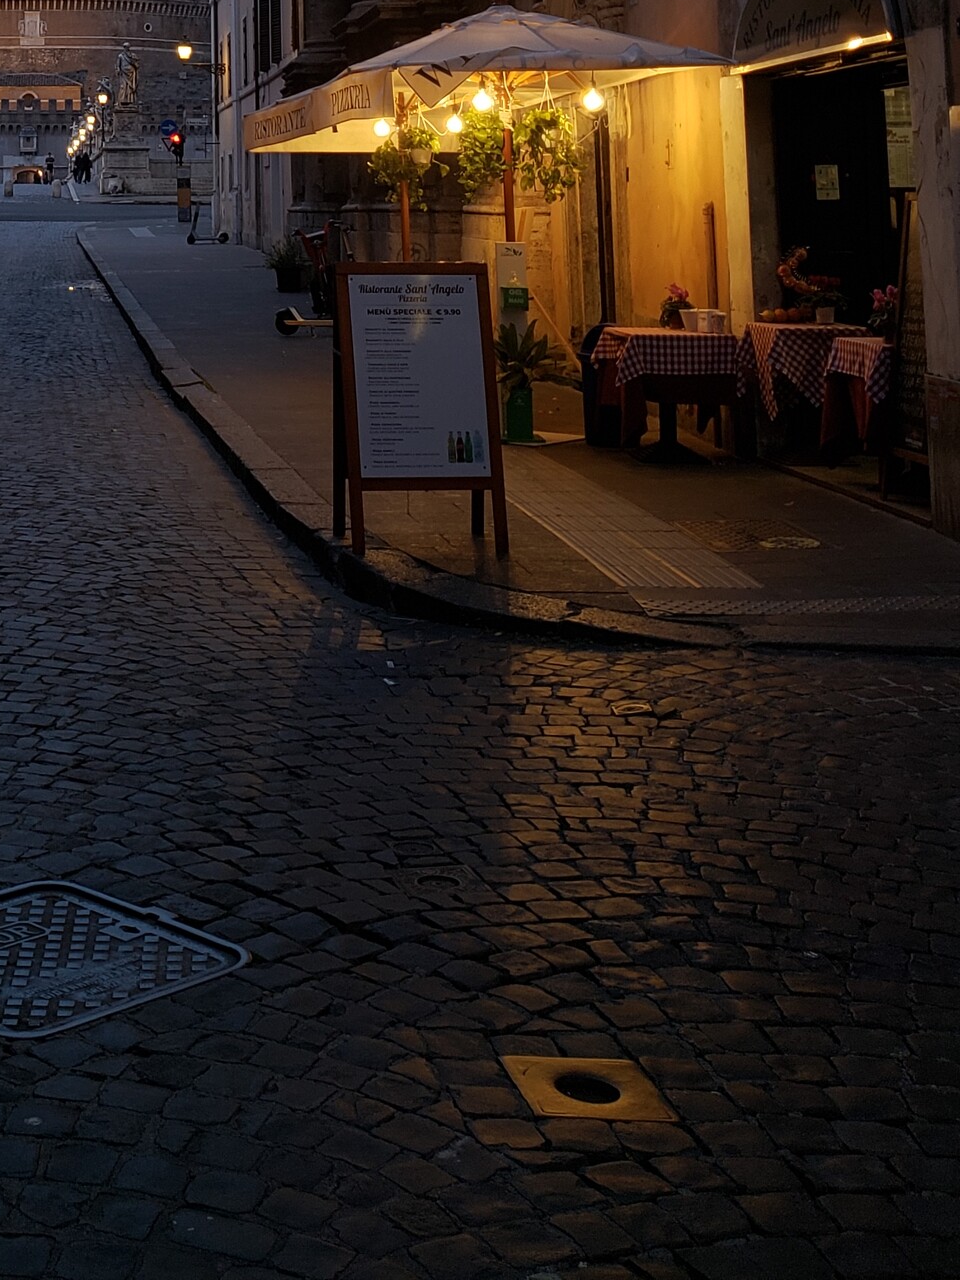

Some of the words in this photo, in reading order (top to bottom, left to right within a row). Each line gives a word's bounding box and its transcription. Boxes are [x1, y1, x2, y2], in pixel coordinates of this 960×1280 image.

[254, 106, 306, 141] RISTORANTE
[359, 284, 403, 294] Ristorante
[398, 294, 428, 303] Pizzeria
[393, 308, 432, 316] SPECIALE
